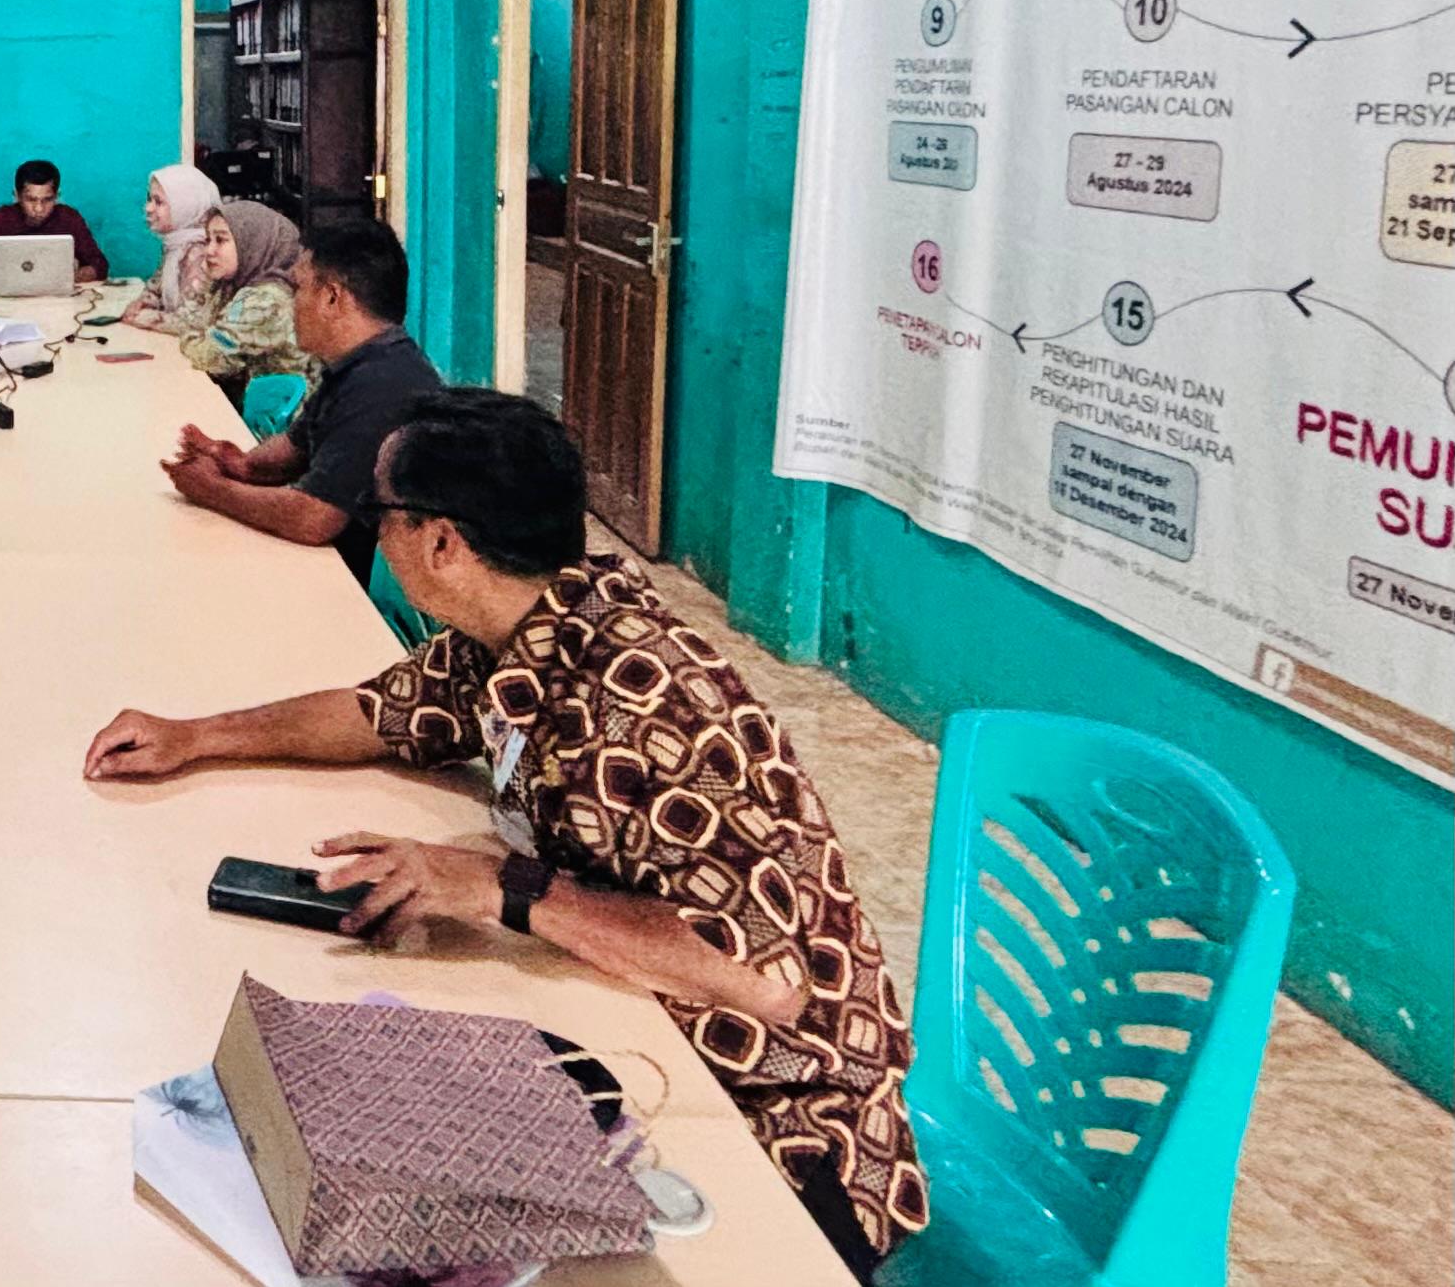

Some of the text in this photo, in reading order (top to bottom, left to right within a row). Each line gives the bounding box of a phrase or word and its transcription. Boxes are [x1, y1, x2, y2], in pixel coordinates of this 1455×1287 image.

[930, 6, 945, 35] 9
[1081, 68, 1218, 91] PENDAFTARAN
[1065, 92, 1235, 118] PASANGAN CALON
[1114, 152, 1133, 169] 27
[1087, 171, 1194, 199] Agustus 2024
[1387, 216, 1409, 238] 21
[918, 254, 939, 281] 16
[1111, 296, 1146, 331] 15
[1042, 341, 1225, 408] PENGHITUNGAN DAN
[1042, 365, 1220, 434] REKAPITULASI HASIL
[1030, 385, 1236, 465] PENGHITUNGAN SUARA
[1089, 449, 1172, 490] November
[1069, 485, 1146, 527] Desember
[1149, 516, 1189, 545] 2024
[1355, 572, 1455, 625] 27 Nove
